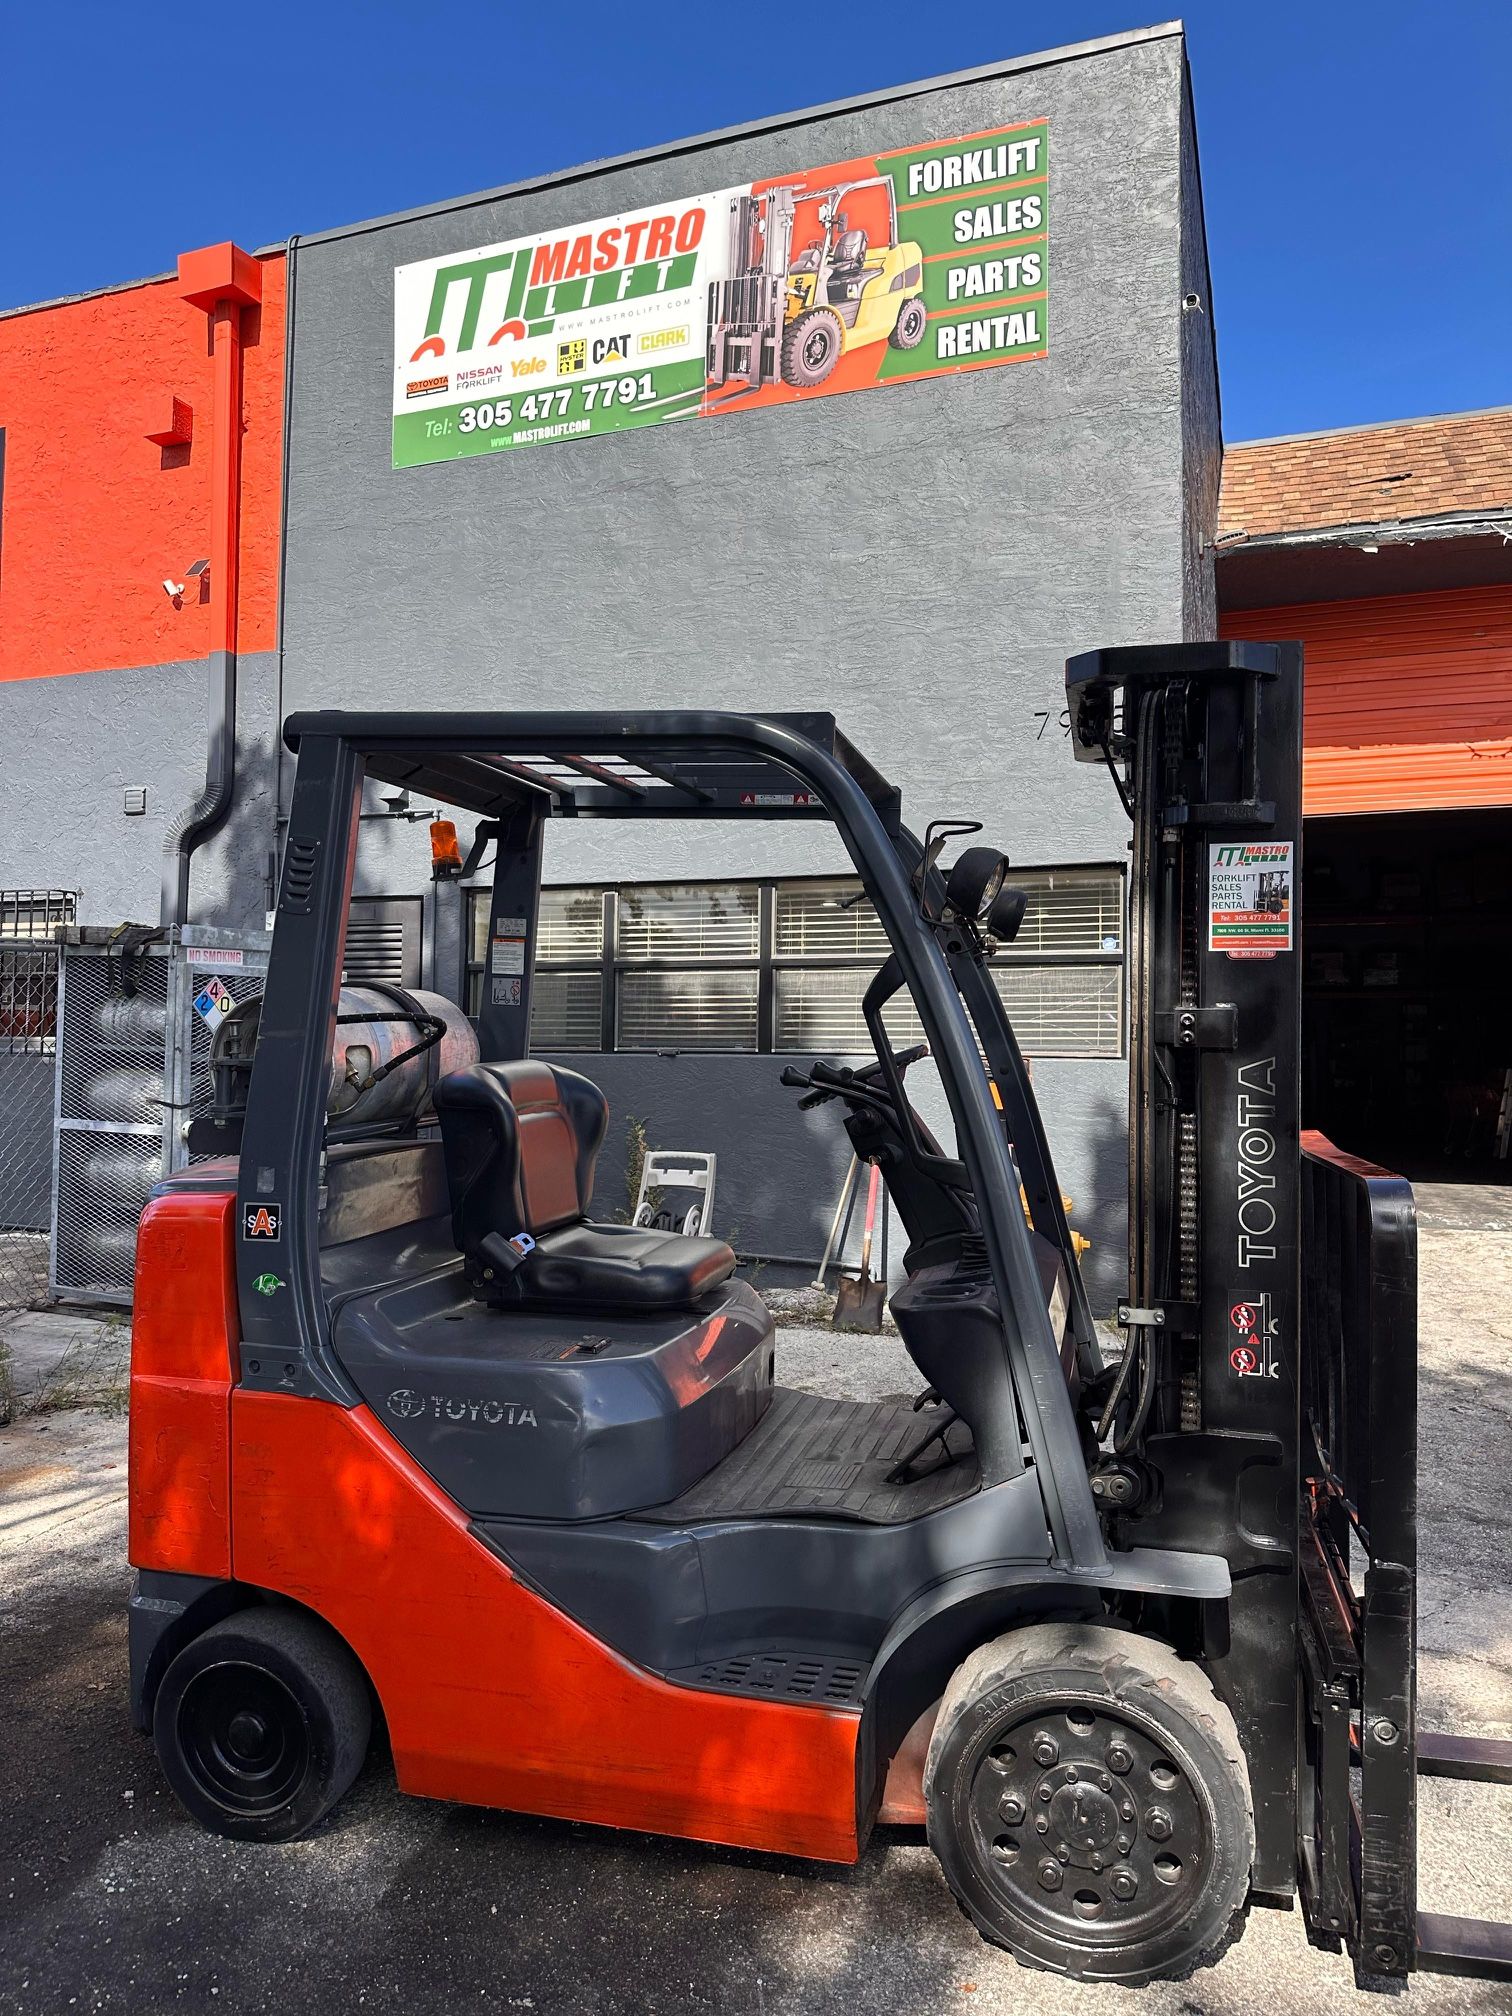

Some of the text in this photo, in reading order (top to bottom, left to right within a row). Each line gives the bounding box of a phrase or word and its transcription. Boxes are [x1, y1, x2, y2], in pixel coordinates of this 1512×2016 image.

[908, 137, 1040, 196] FORKLIFT
[954, 195, 1042, 243] SALES
[529, 207, 706, 287] MASTRO
[948, 253, 1042, 301] PARTS
[543, 260, 673, 316] LIFT
[640, 328, 686, 351] CLARK
[937, 310, 1041, 359] RENTAL
[560, 352, 585, 362] HYSTER
[592, 333, 632, 365] CAT
[456, 365, 503, 382] NISSAN
[511, 356, 547, 378] Yale
[418, 376, 448, 389] TOYOTA
[456, 375, 502, 391] FORKLIFT
[425, 372, 658, 438] Tel: 305 477 7791
[1245, 845, 1290, 855] MASTRO
[1211, 873, 1257, 882] FORKLIFT
[1211, 883, 1242, 892] SALES
[1211, 892, 1243, 900] PARTS
[1211, 901, 1248, 910] RENTAL
[1264, 913, 1281, 921] 7791
[189, 949, 242, 963] NO SMOKING
[210, 981, 219, 999] 4
[200, 994, 209, 1011] 2
[220, 996, 230, 1013] 0
[1238, 1056, 1277, 1267] TOYOTA
[430, 1395, 538, 1428] TOYOTA
